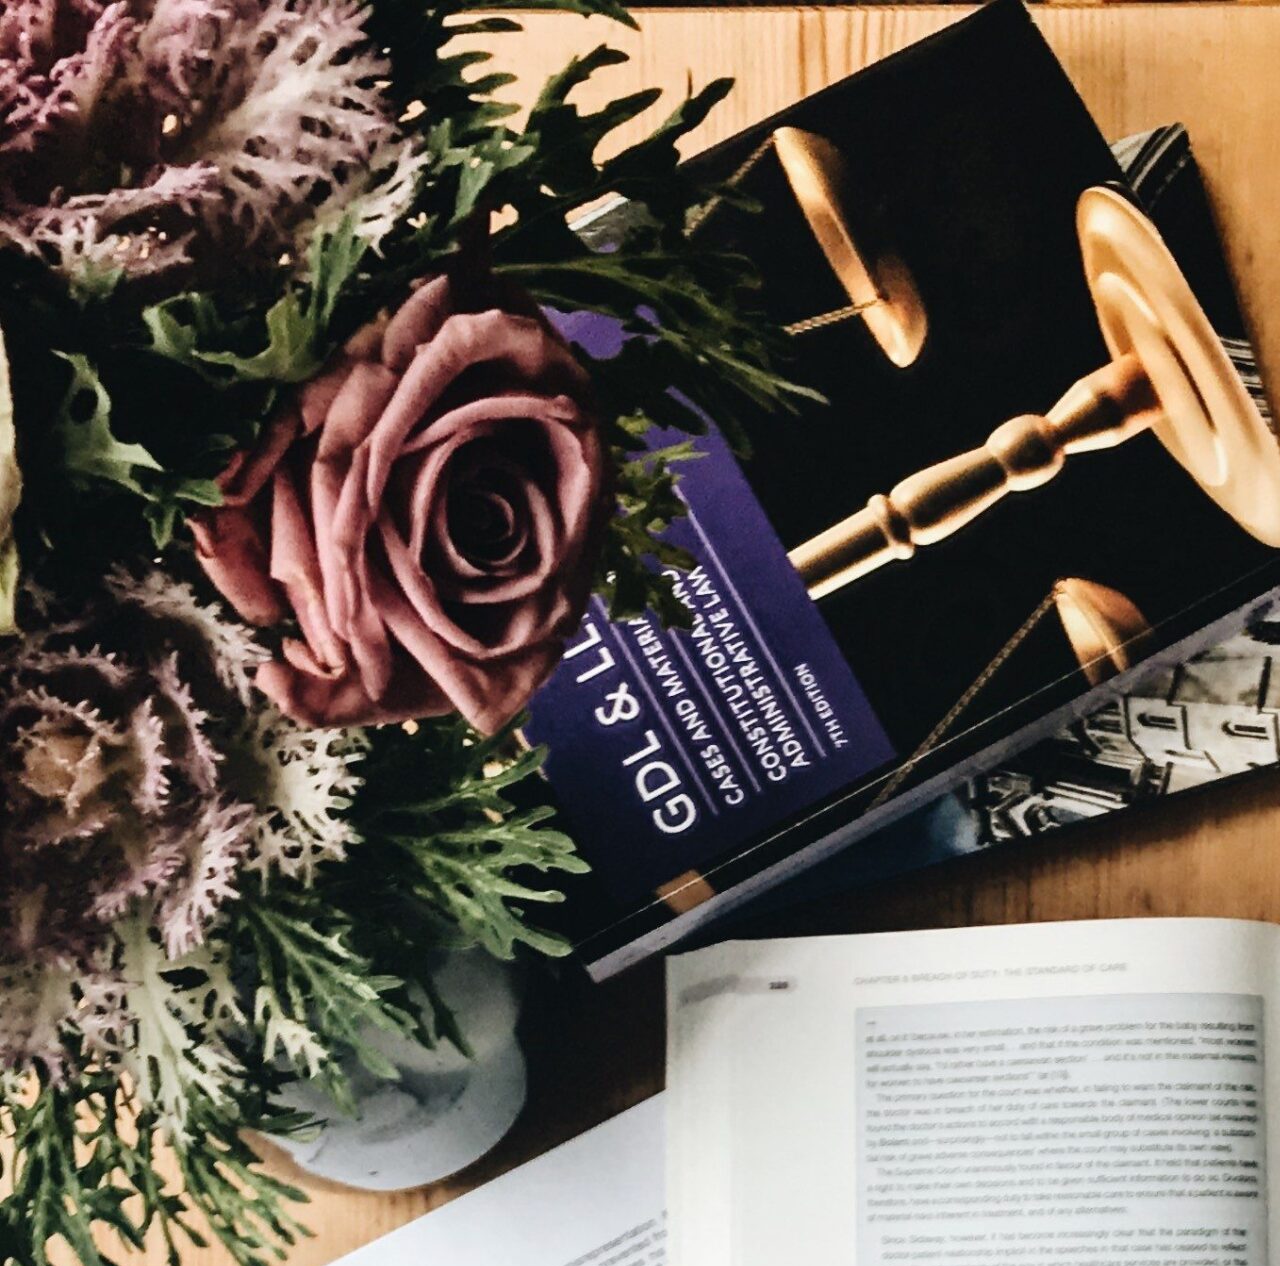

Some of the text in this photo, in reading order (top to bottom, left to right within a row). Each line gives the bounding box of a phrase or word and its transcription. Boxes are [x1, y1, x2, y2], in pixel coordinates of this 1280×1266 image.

[563, 612, 697, 834] GDL & LL
[676, 699, 712, 740] AND
[691, 613, 787, 781] CONSTITUTIONAL
[713, 608, 811, 768] ADMINISTRATIVE
[794, 663, 849, 749] 7TH EDITION
[700, 744, 744, 805] CASES
